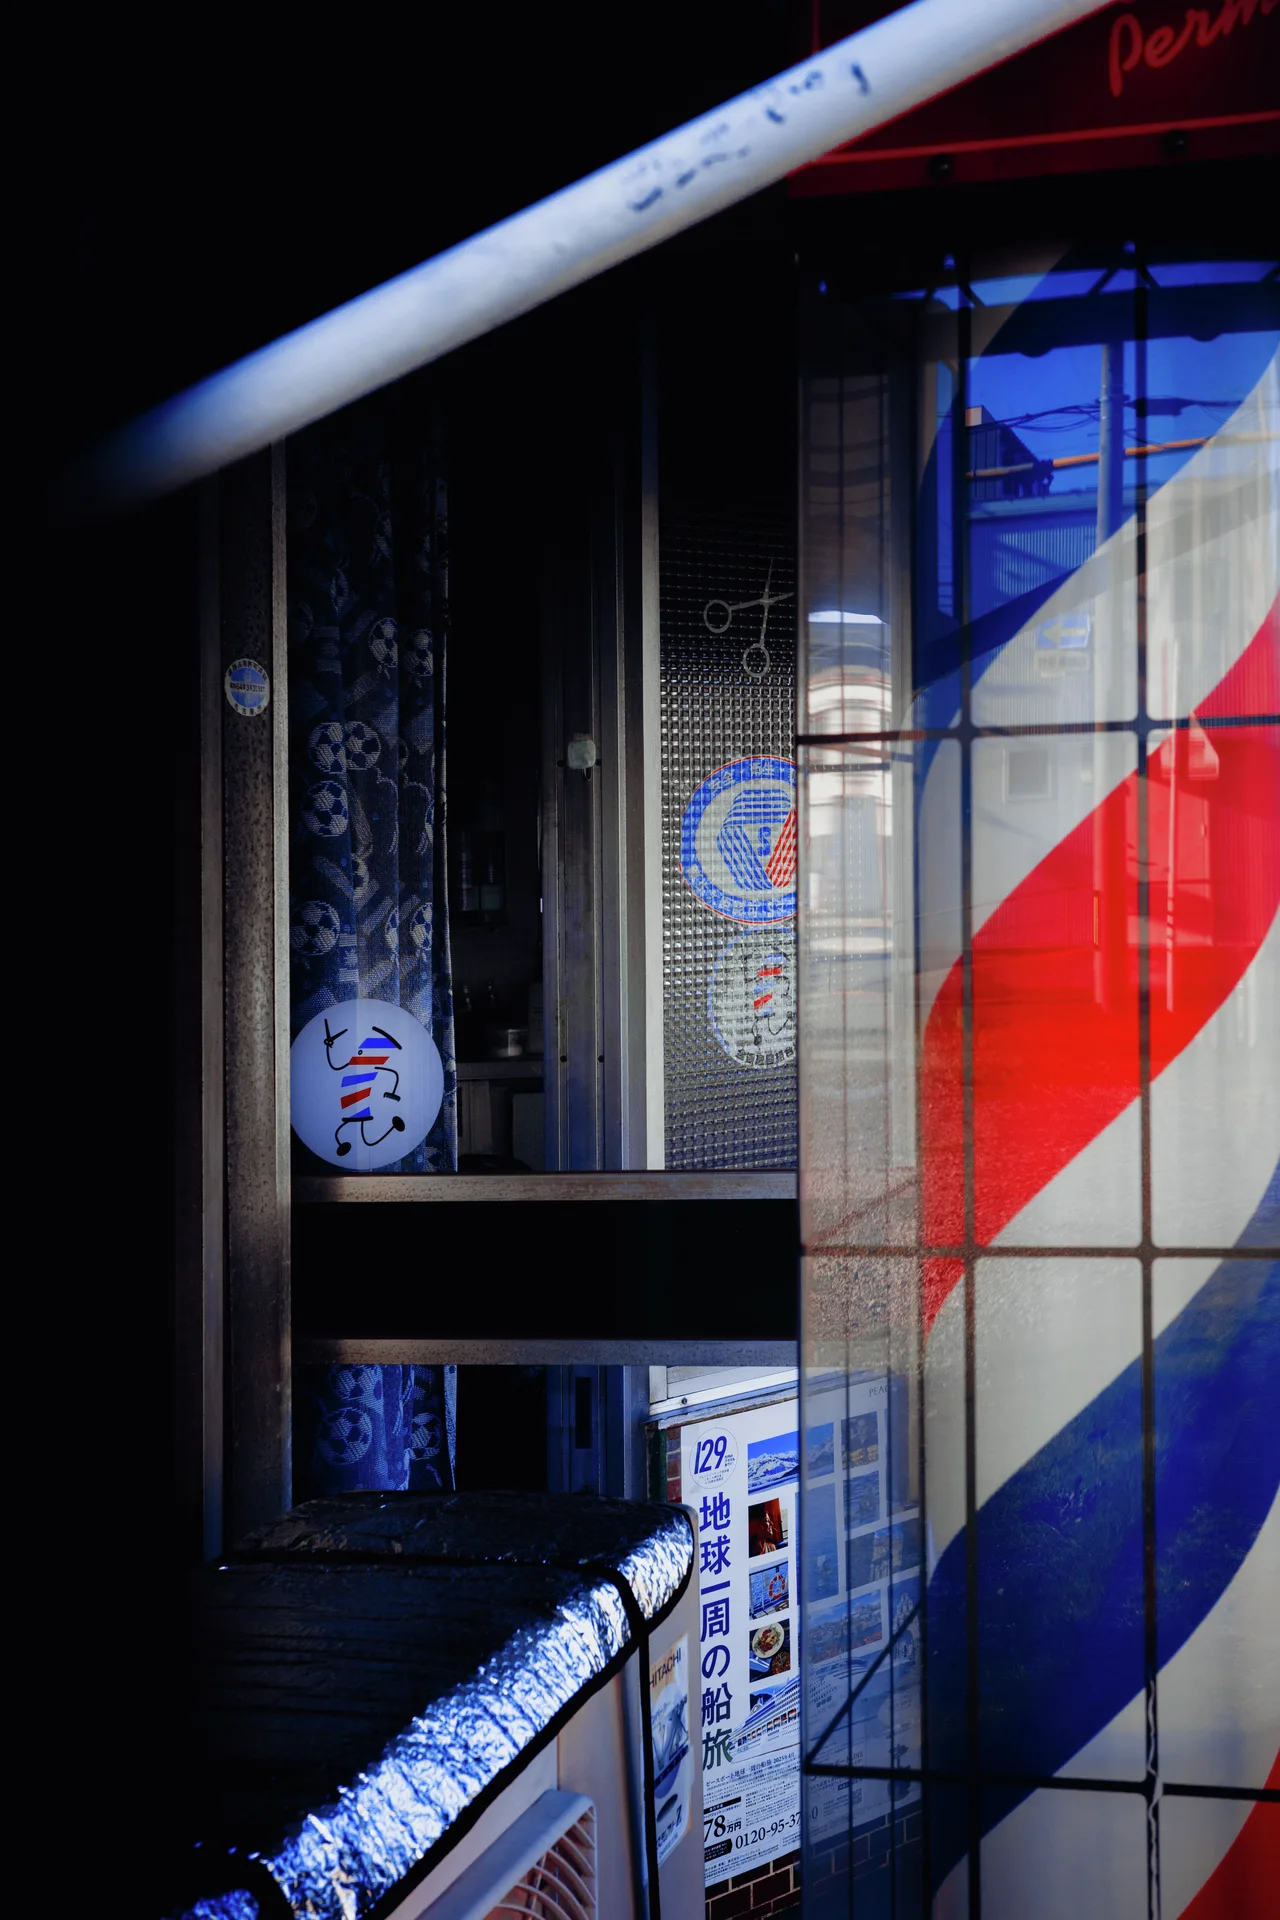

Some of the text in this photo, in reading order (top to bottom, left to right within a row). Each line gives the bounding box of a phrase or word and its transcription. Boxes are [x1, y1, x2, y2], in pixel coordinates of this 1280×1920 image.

[694, 1435, 728, 1475] 129
[699, 1492, 733, 1771] 地球一周の船旅
